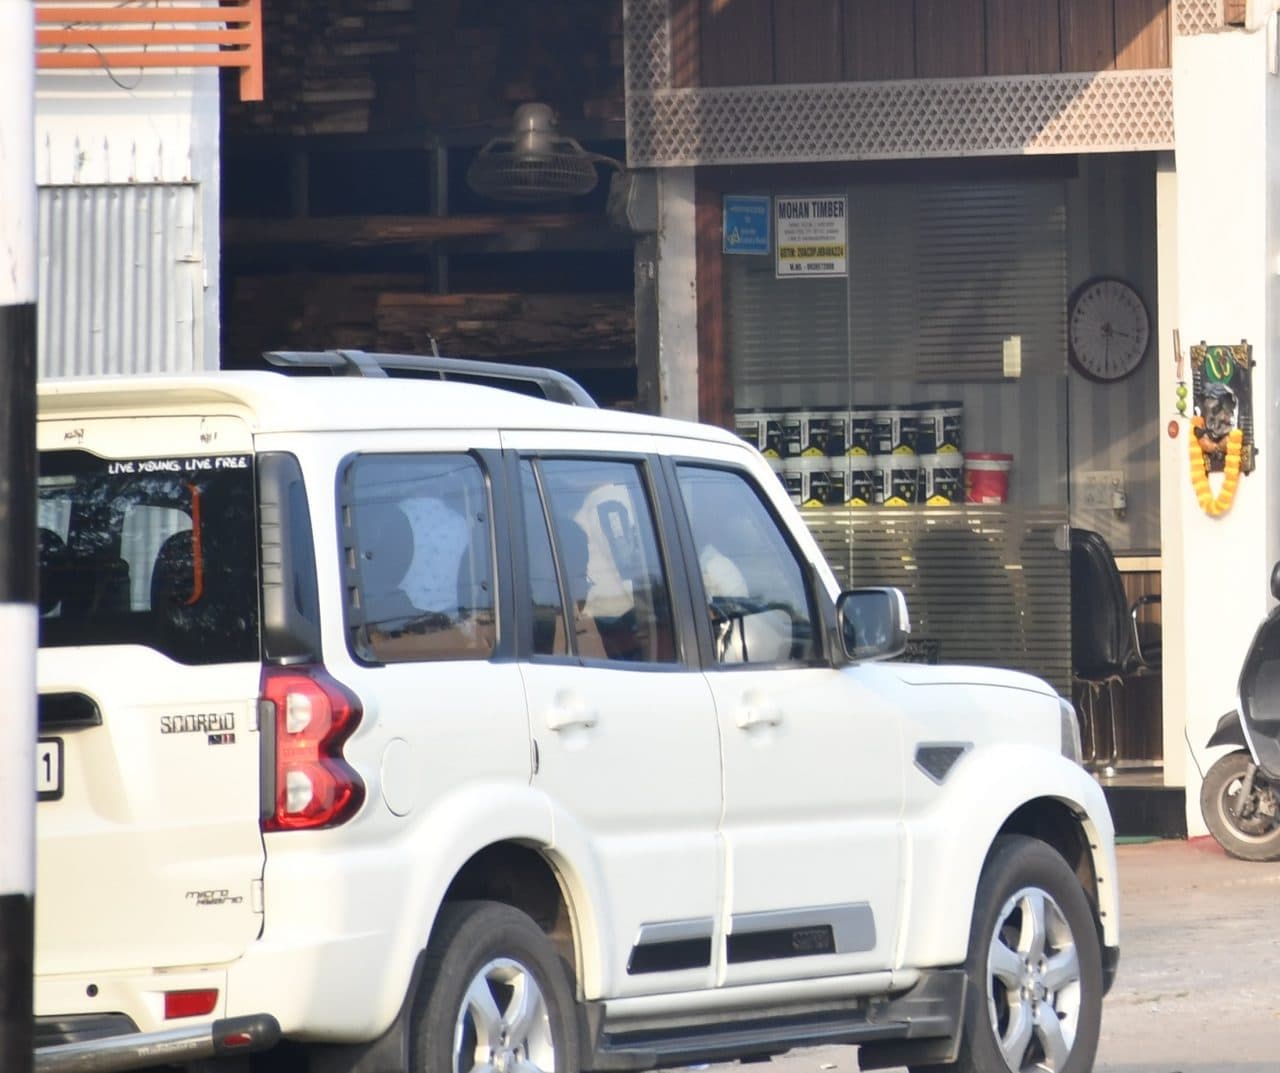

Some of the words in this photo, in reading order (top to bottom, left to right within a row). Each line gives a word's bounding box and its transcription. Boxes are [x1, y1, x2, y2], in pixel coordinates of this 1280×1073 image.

[778, 201, 810, 219] MOHAN
[813, 200, 844, 218] TIMBER
[108, 461, 134, 474] LIVE
[185, 458, 213, 472] LIVE
[215, 457, 248, 469] FREE
[160, 712, 235, 734] SCORPIO
[42, 752, 51, 783] 1
